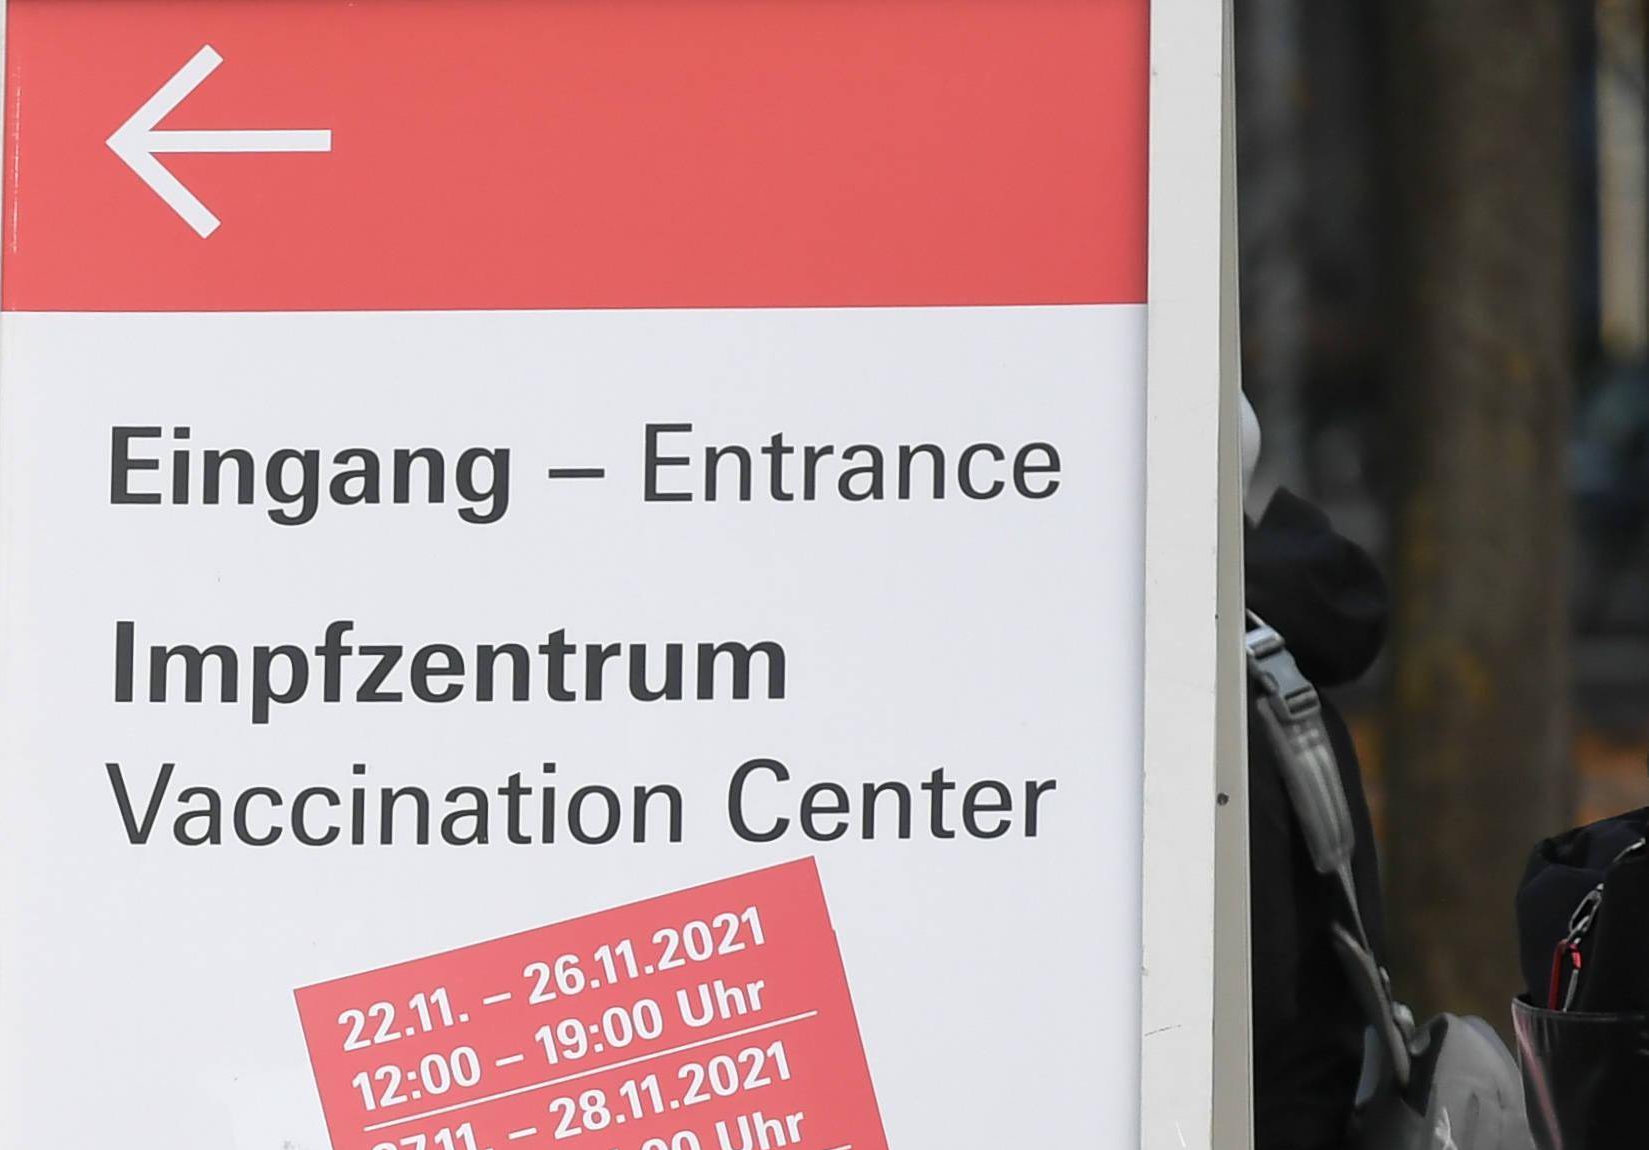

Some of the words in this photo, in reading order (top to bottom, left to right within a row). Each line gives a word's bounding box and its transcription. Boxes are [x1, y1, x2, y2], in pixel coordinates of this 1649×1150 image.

[110, 426, 511, 526] Eingang
[644, 423, 1061, 502] Entrance
[114, 620, 786, 725] Impfzentrum
[105, 762, 683, 847] Vaccination
[728, 758, 1057, 843] Center
[337, 987, 470, 1052] 22.11.
[523, 906, 765, 1005] 26.11.2021
[351, 1046, 481, 1112] 12:00
[534, 998, 663, 1065] 19:00
[676, 979, 765, 1028] Uhr
[548, 1041, 791, 1140] 28.11.2021
